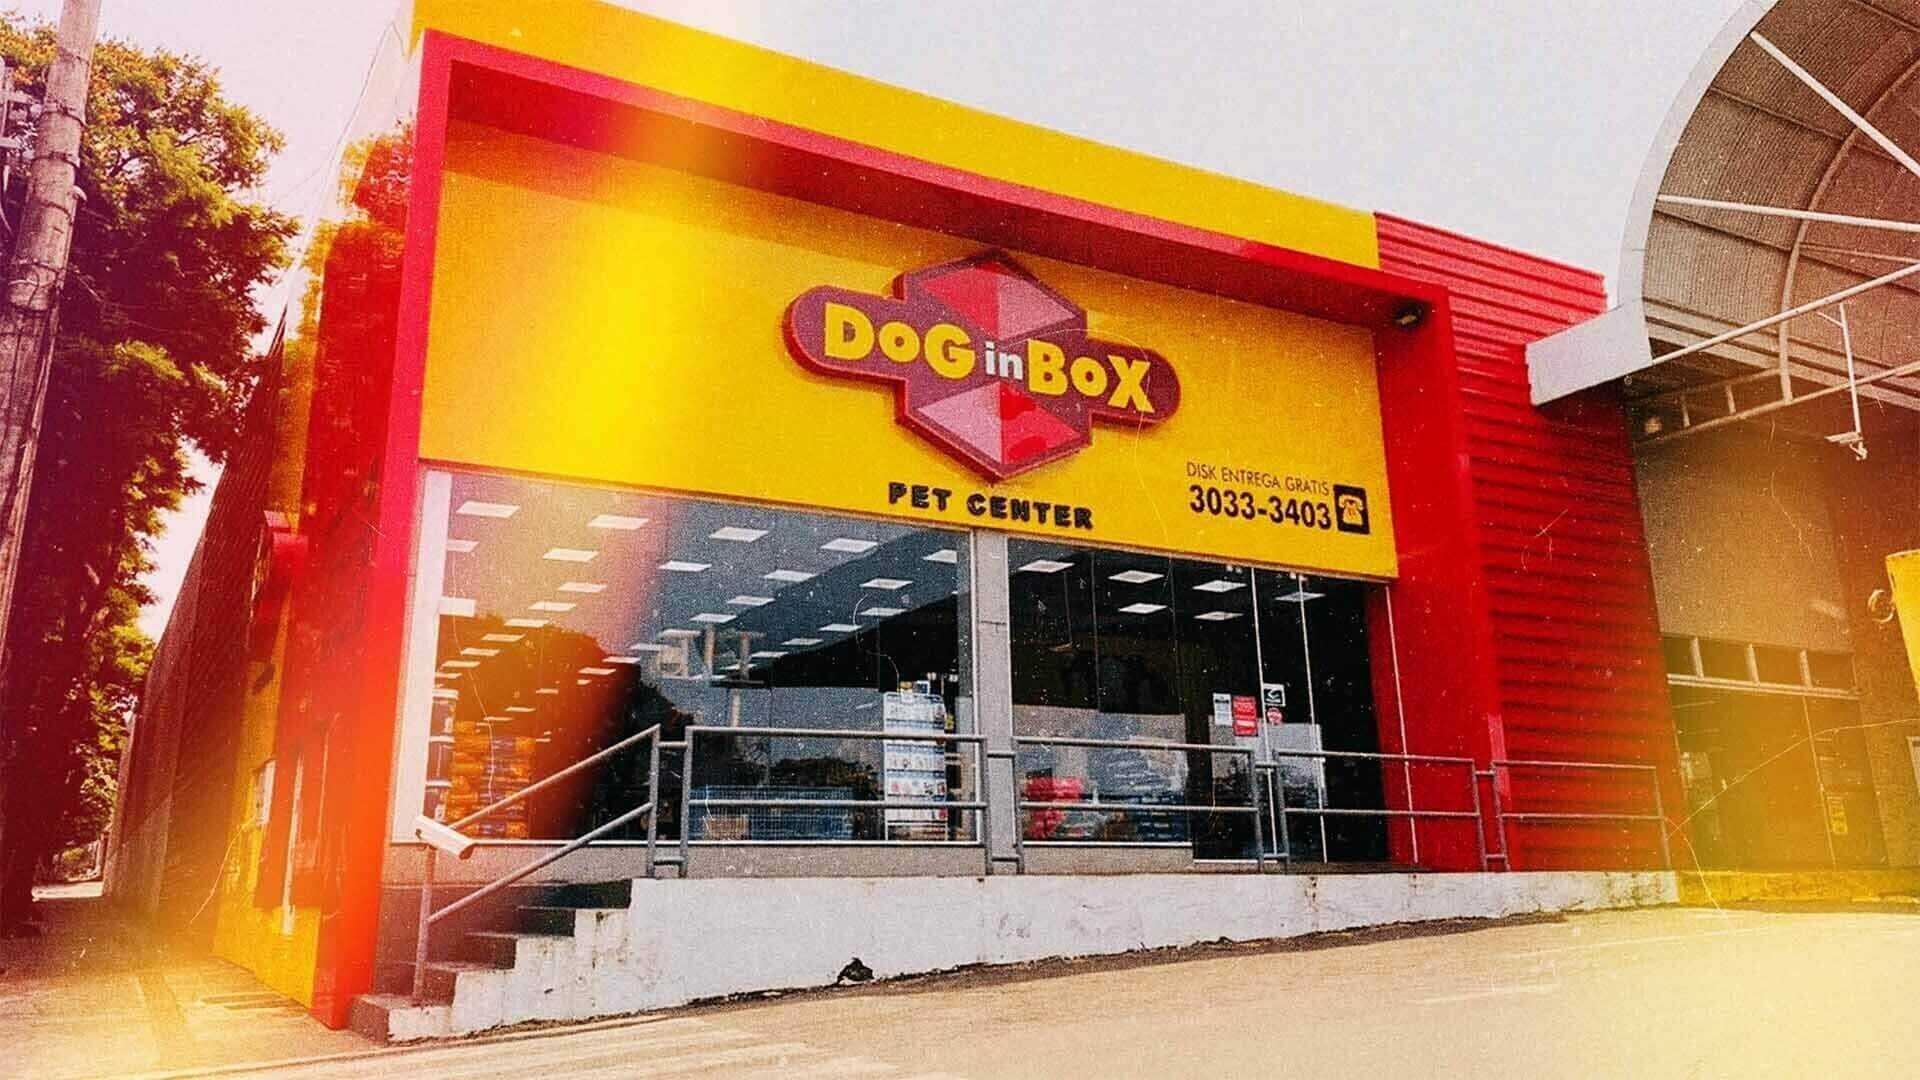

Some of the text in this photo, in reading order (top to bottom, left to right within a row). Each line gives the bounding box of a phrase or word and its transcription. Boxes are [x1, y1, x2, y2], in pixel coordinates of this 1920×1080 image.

[984, 342, 1024, 382] in
[1187, 462, 1330, 496] DISK ENTREGA GRATIS
[888, 482, 1093, 530] PET CENTER
[1189, 484, 1332, 530] 3033-3403
